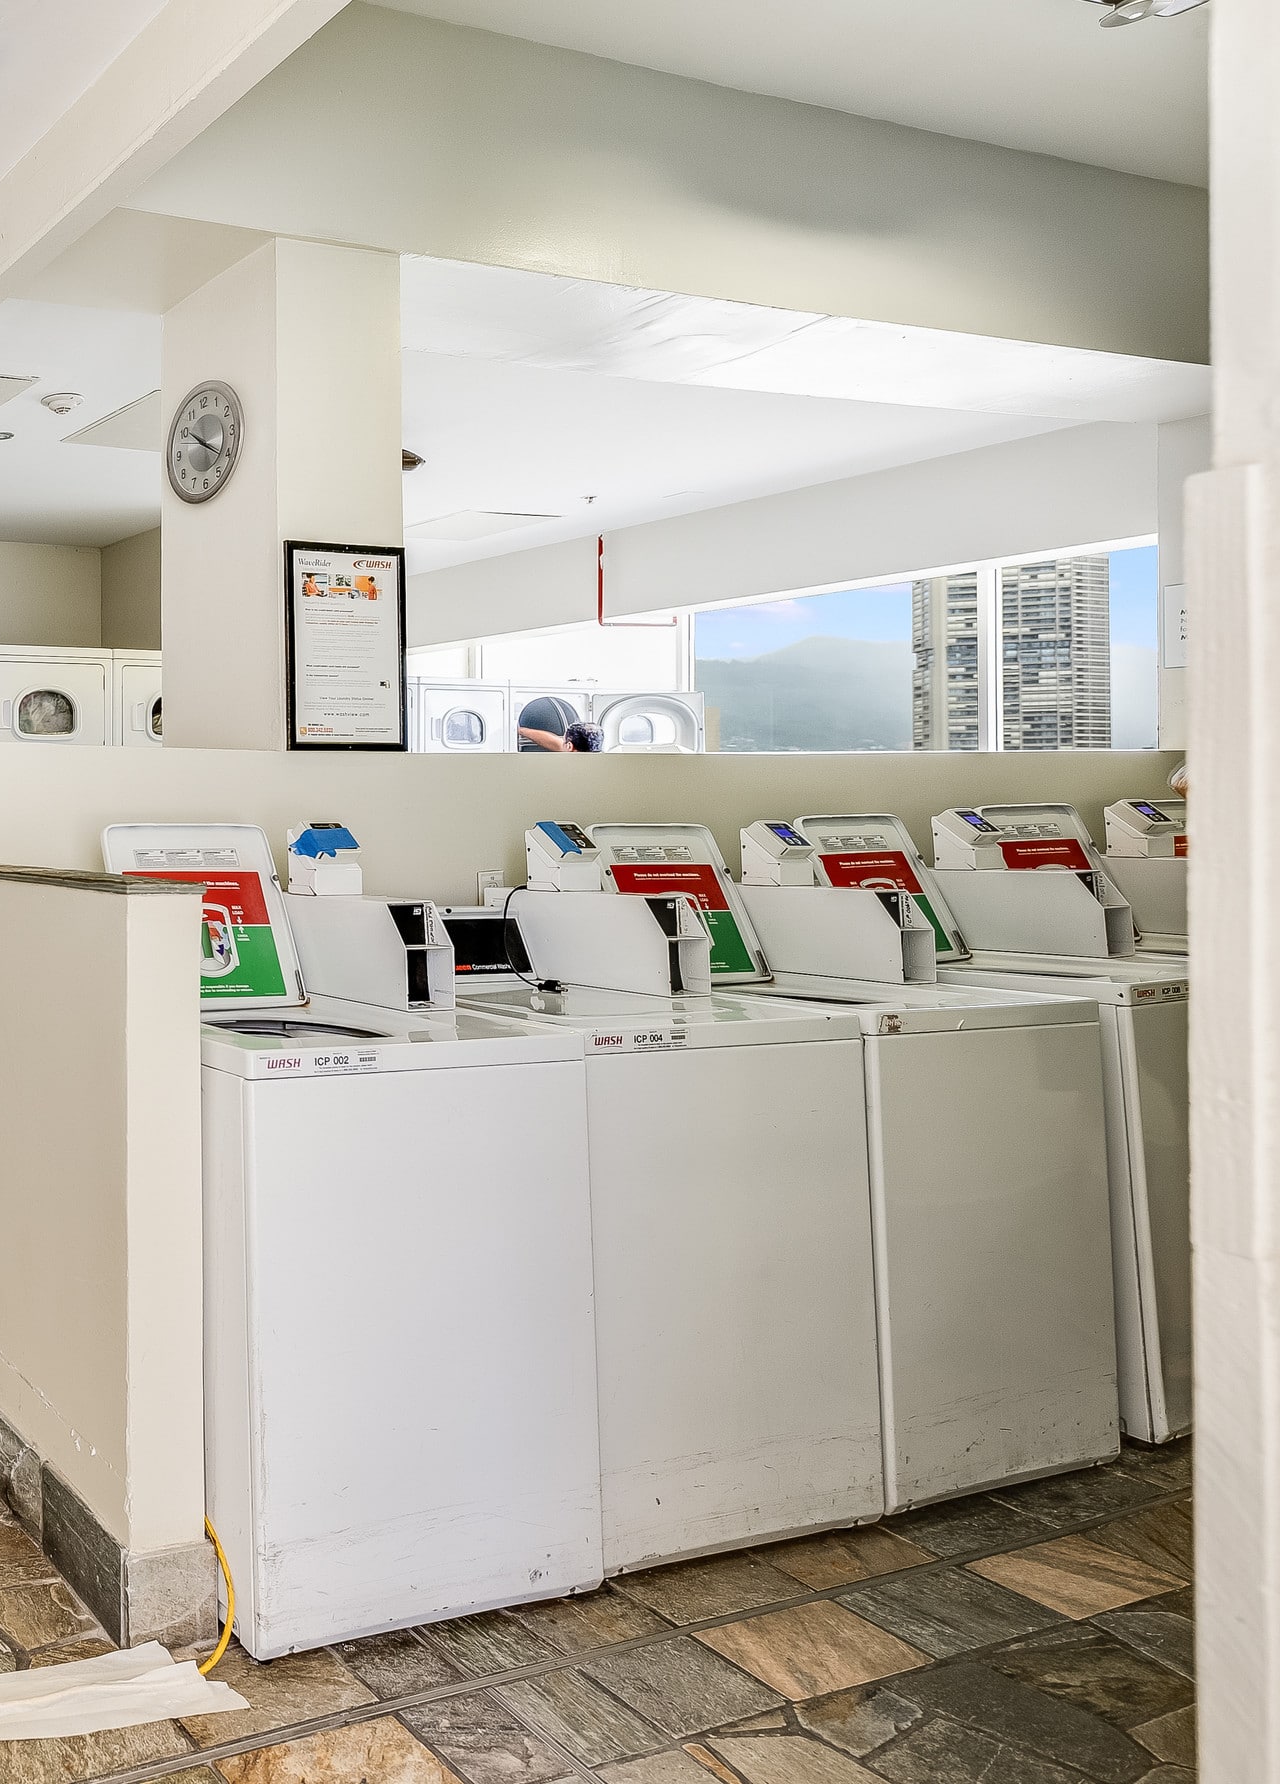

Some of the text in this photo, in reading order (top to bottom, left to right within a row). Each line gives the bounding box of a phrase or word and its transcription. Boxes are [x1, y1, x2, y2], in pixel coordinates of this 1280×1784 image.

[199, 396, 208, 409] 12
[214, 396, 218, 408] 1
[188, 410, 195, 421] 11
[223, 405, 230, 418] 2
[180, 427, 189, 439] 10
[229, 424, 235, 436] 3
[176, 450, 182, 462] 9
[225, 448, 231, 458] 4
[181, 468, 186, 479] 8
[215, 466, 221, 478] 5
[191, 478, 197, 488] 7
[203, 478, 209, 489] 6
[298, 558, 332, 567] WaveRider
[365, 560, 393, 569] WASH
[594, 1036, 623, 1046] WASH
[633, 1034, 663, 1044] ICP 004
[267, 1058, 301, 1069] WASH
[314, 1055, 349, 1066] ICP 002
